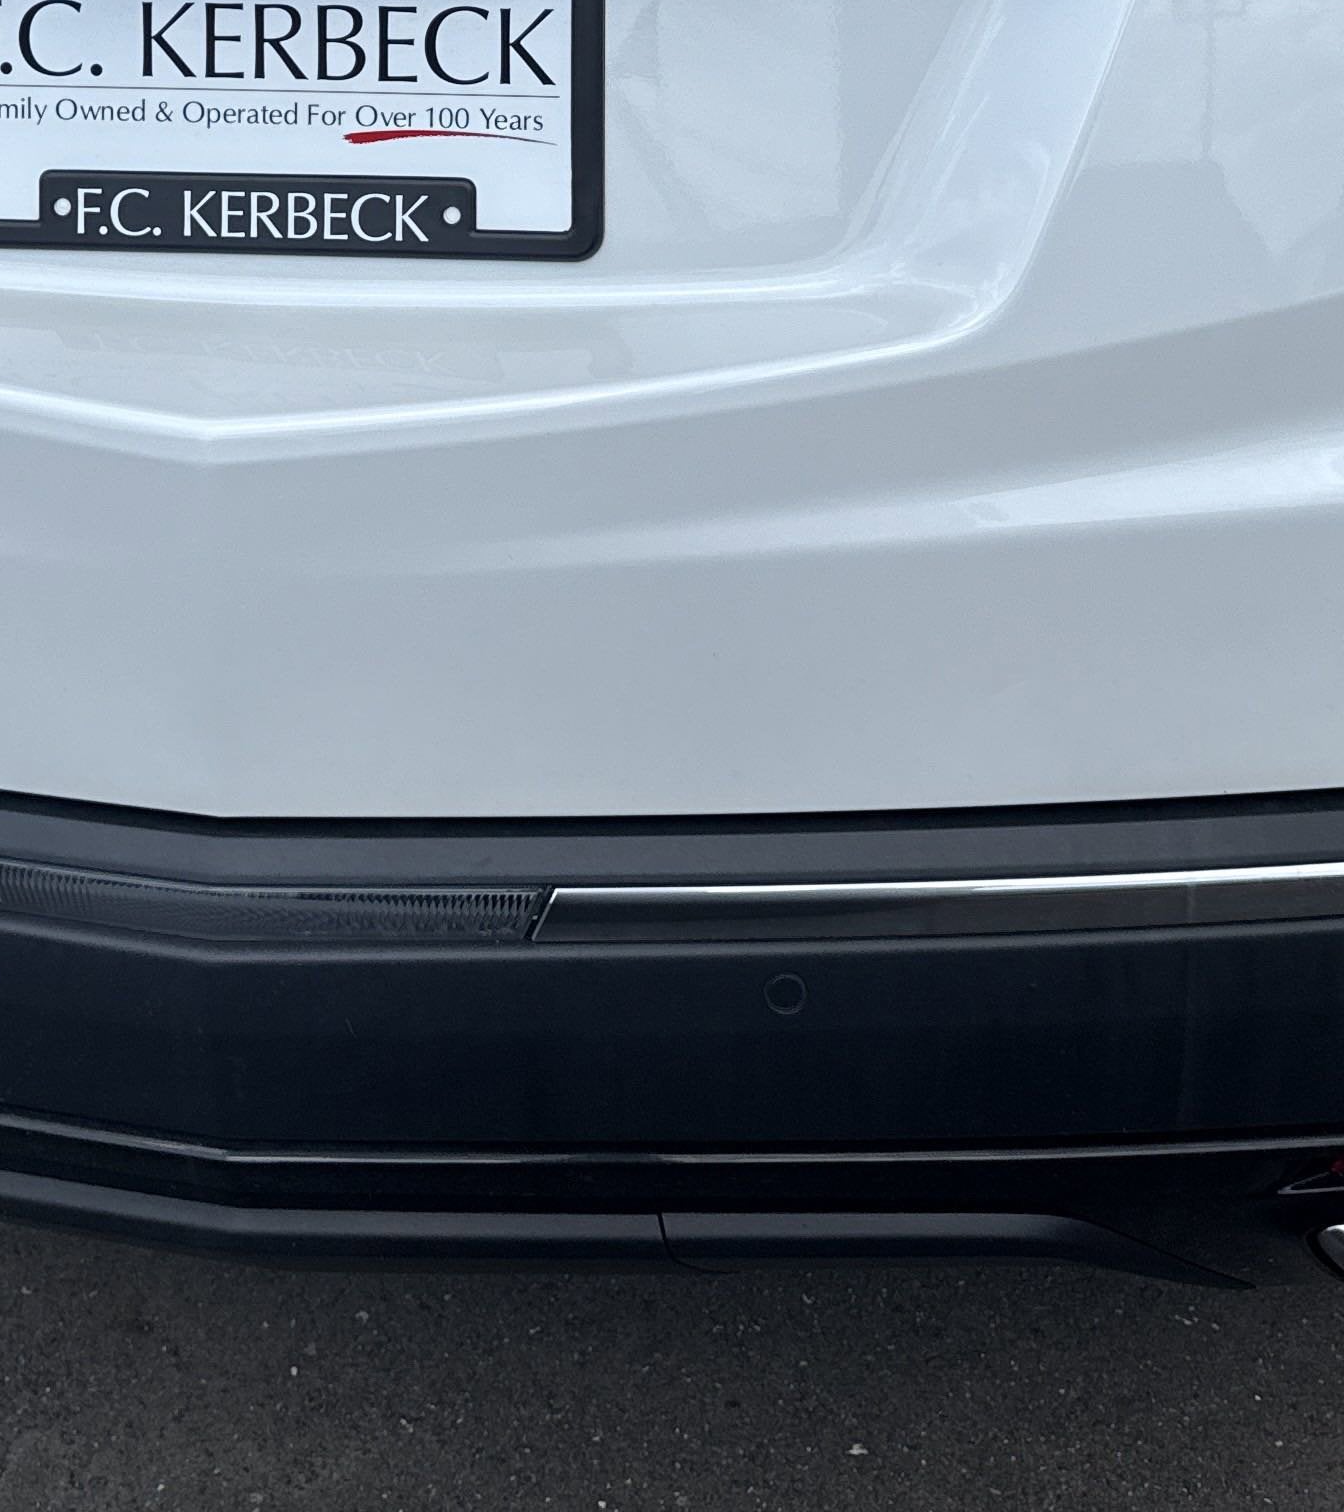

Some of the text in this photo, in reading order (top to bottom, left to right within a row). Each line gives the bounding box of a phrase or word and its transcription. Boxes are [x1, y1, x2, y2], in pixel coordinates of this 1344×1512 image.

[142, 2, 556, 86] KERBECK
[56, 98, 146, 122] Owned
[155, 100, 173, 123] &
[182, 100, 298, 129] Operated
[308, 104, 346, 126] For
[356, 105, 416, 128] Over
[426, 107, 470, 130] 100
[479, 108, 544, 131] Years
[77, 188, 429, 243] F.C. KERBECK
